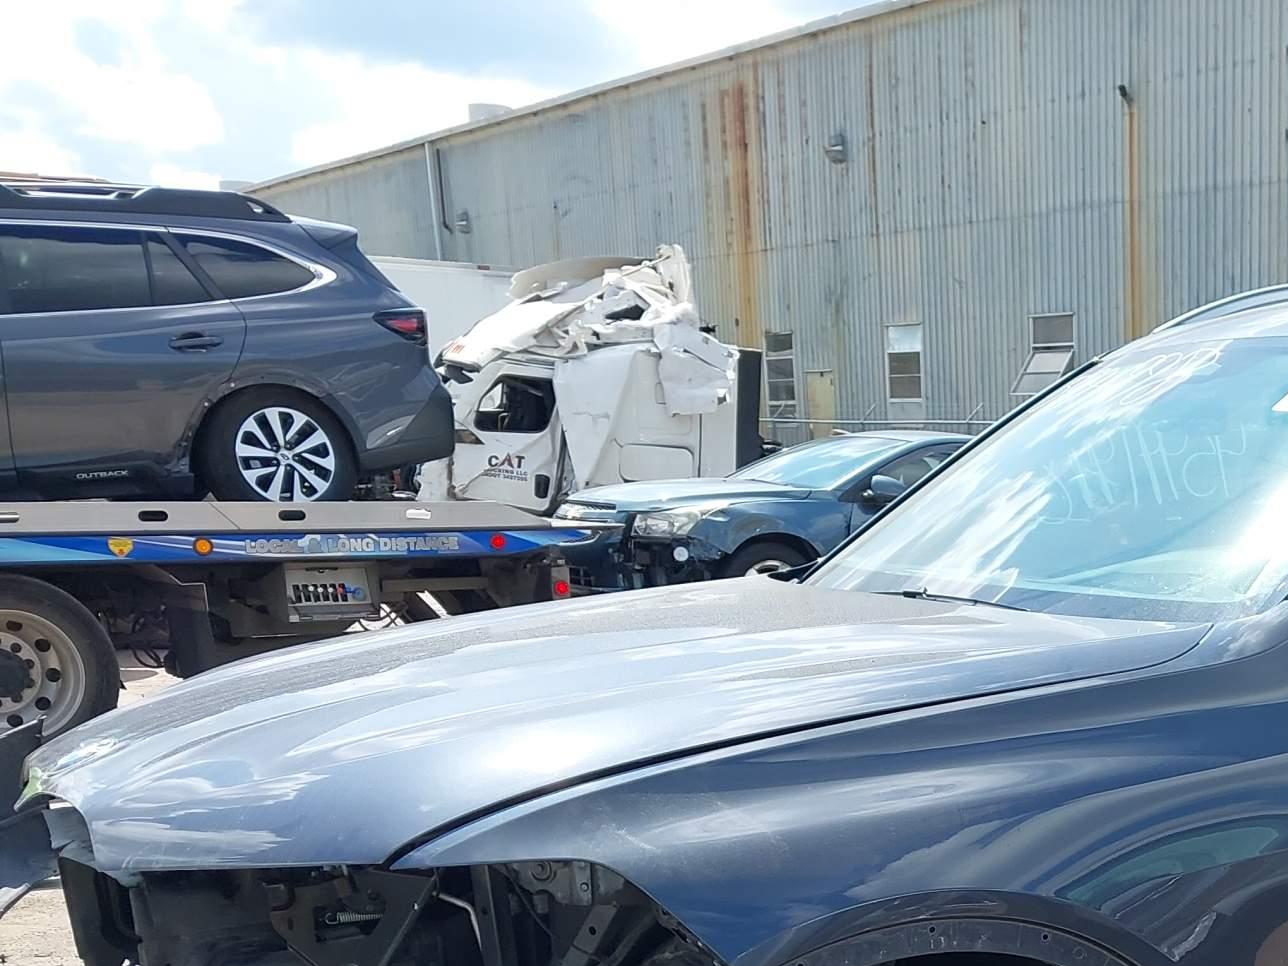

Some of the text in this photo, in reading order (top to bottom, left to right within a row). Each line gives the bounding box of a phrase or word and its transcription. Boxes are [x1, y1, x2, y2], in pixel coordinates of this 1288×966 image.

[487, 452, 526, 468] CAT
[76, 470, 128, 478] OUTBACK
[328, 538, 375, 553] LONG
[380, 536, 459, 552] DISTANCE
